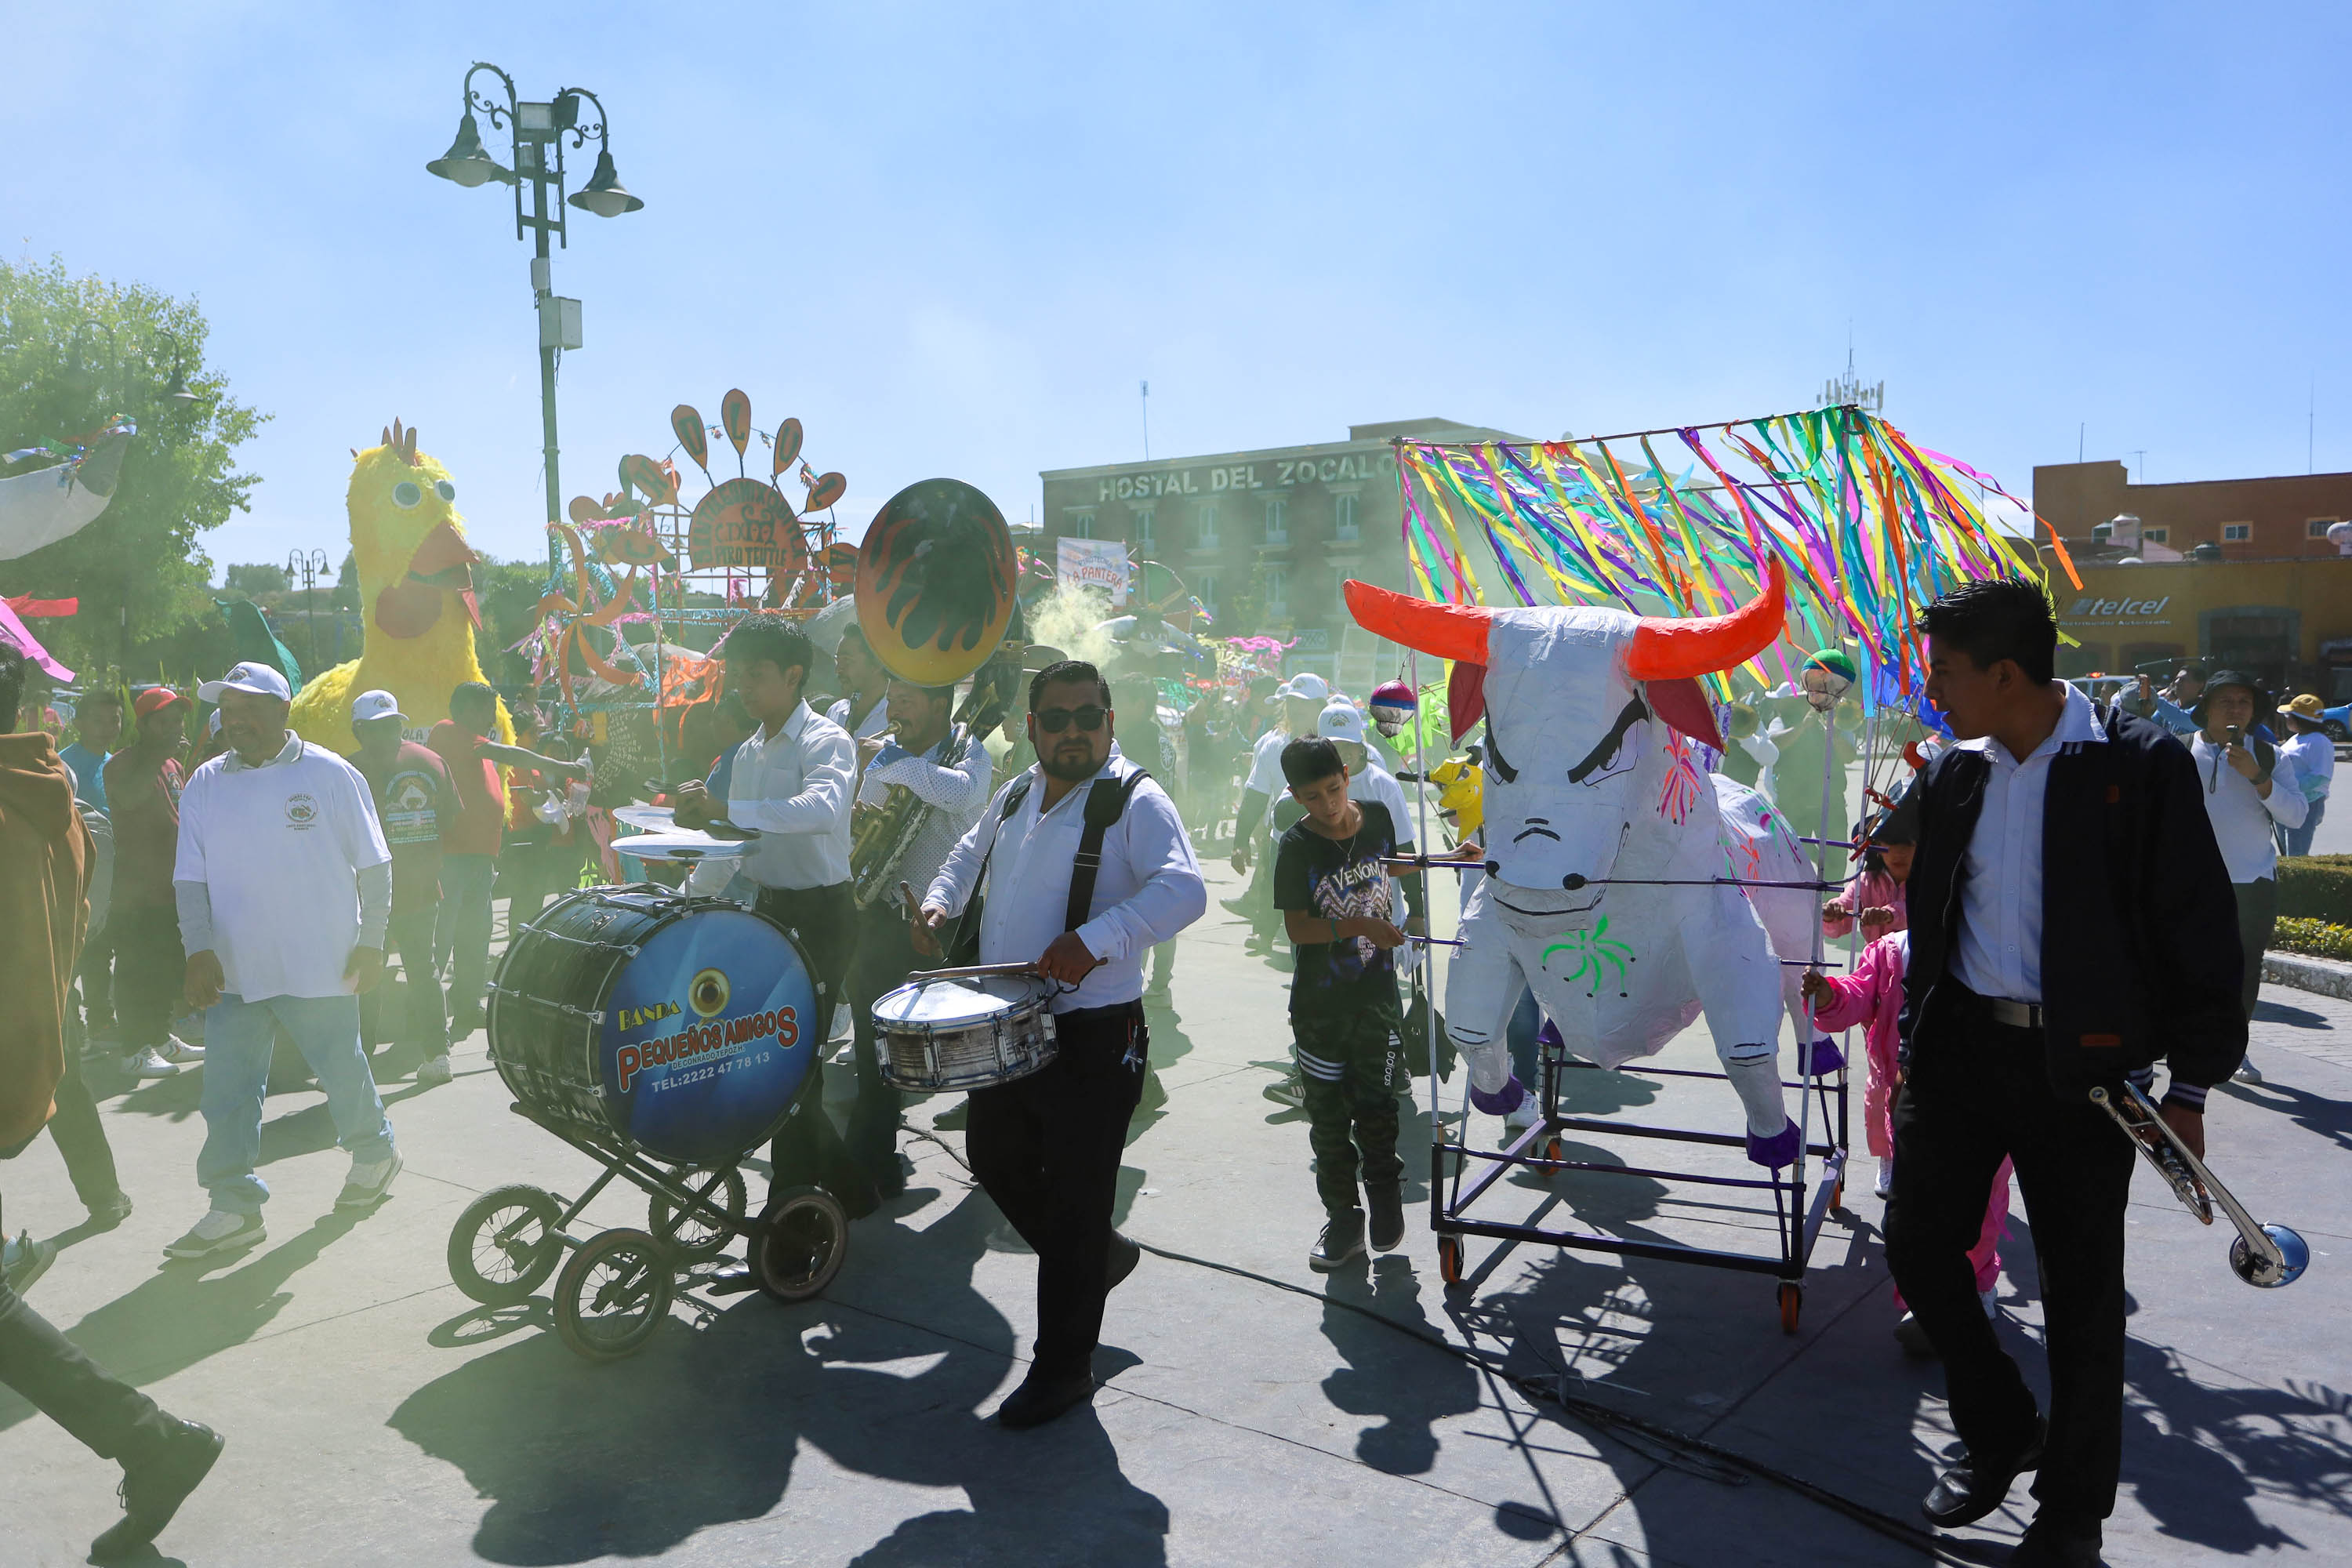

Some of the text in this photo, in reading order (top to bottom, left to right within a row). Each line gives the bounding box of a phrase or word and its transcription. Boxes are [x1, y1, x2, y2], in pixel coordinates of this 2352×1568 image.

[1099, 453, 1394, 502] HOSTAL DEL ZOCALO
[1082, 567, 1123, 590] PANTERA
[2089, 596, 2170, 615] telcel
[1332, 861, 1381, 891] VENOM
[619, 1000, 682, 1032] BANDA
[618, 1005, 799, 1092] PEQUEÑOS AMIGOS
[718, 1062, 732, 1074] 47
[736, 1058, 751, 1069] 78
[755, 1051, 771, 1063] 13
[672, 1061, 682, 1069] DE
[1385, 1051, 1396, 1086] adidas
